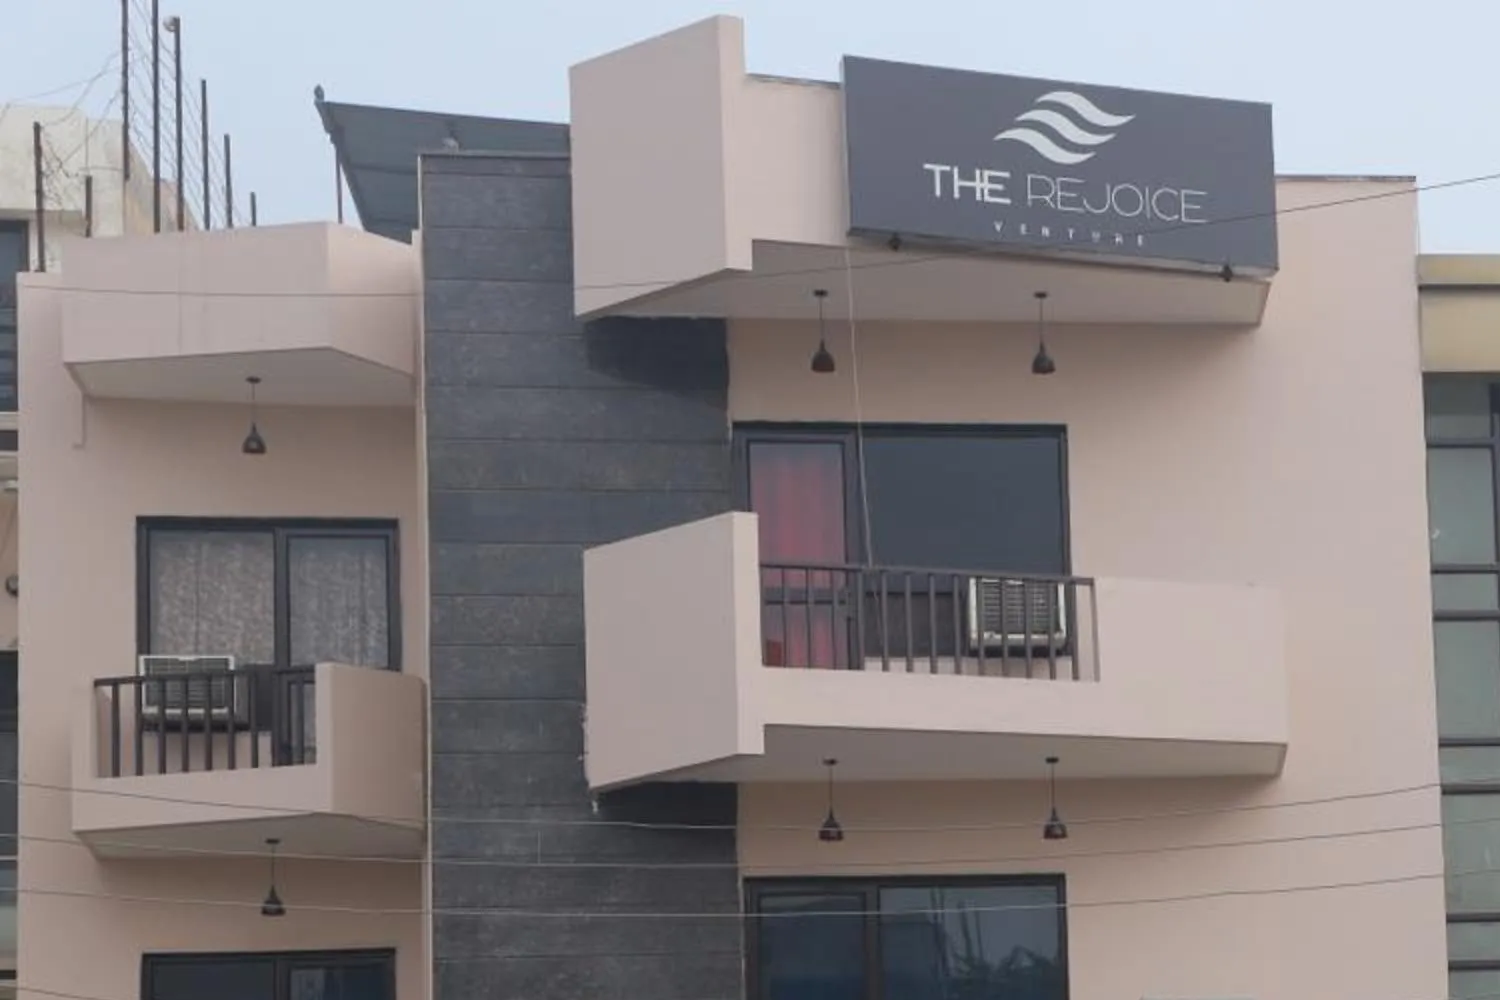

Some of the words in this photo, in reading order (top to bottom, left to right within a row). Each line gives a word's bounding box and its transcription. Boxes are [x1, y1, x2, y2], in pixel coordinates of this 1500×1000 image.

[923, 163, 1012, 205] THE
[1026, 174, 1208, 223] REJOICE
[994, 221, 1146, 247] VENTURE
